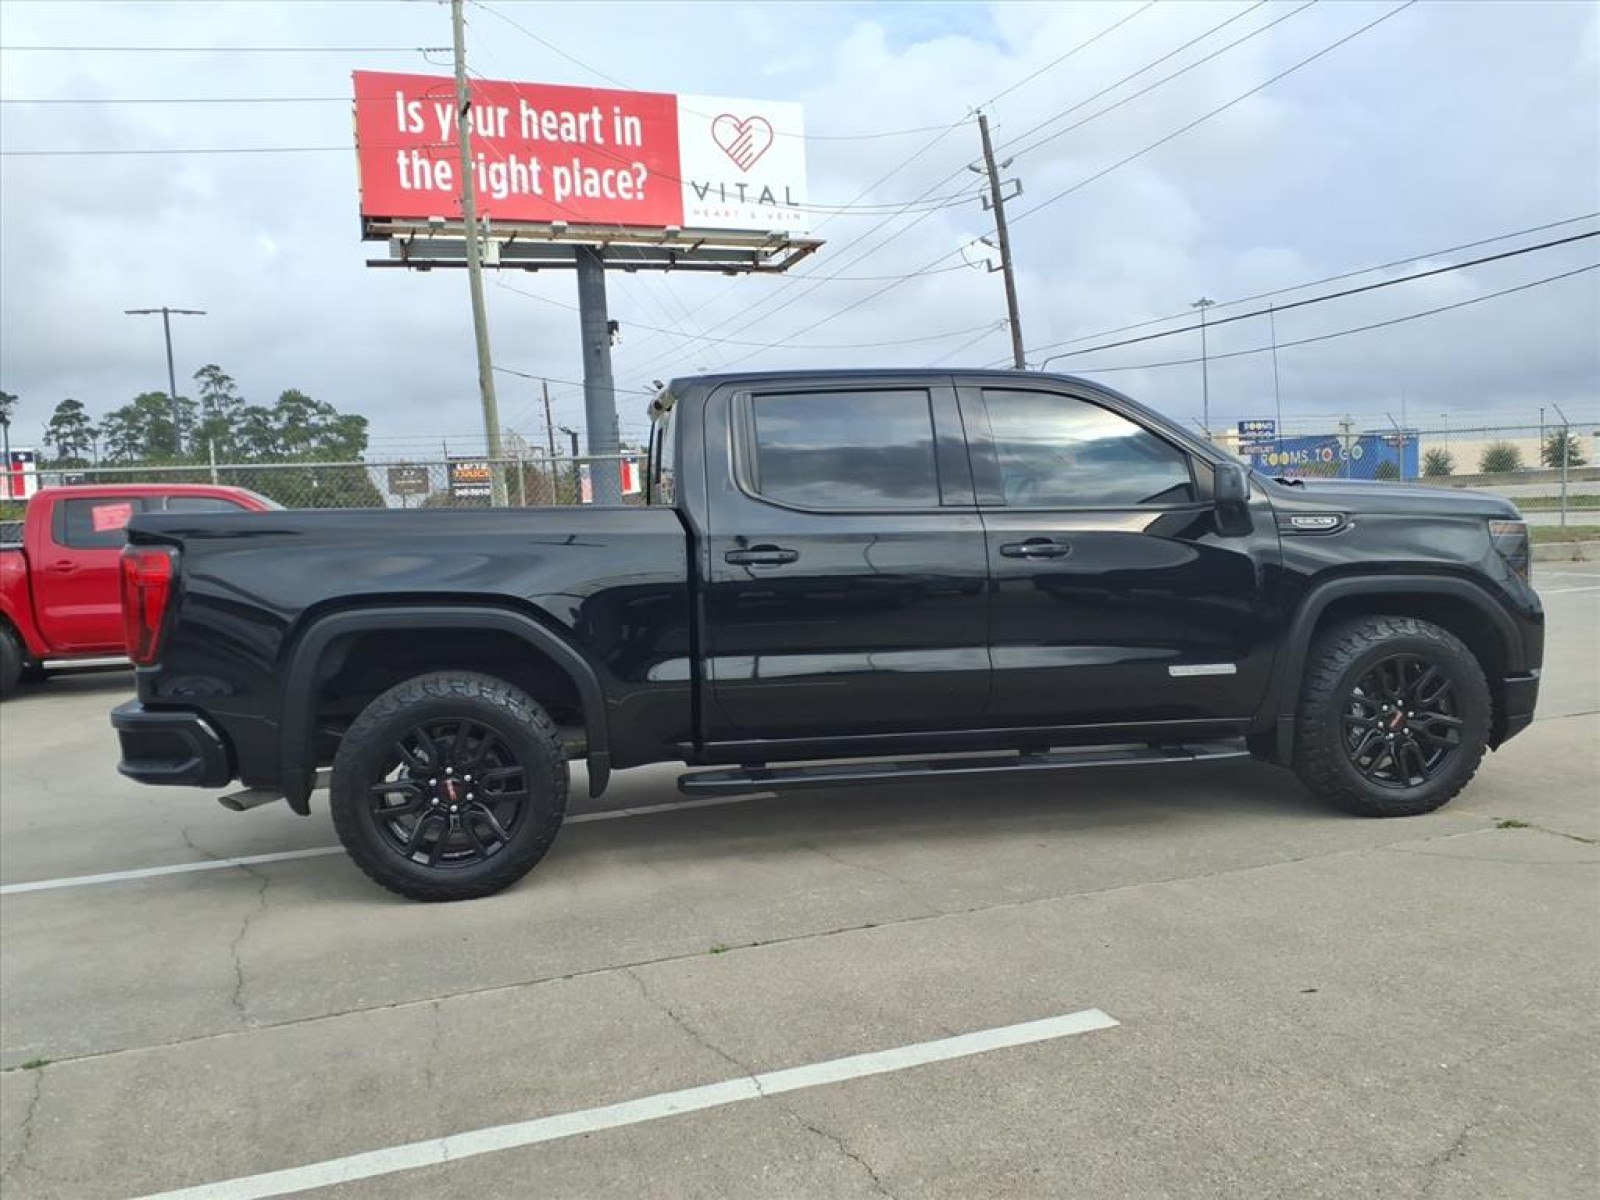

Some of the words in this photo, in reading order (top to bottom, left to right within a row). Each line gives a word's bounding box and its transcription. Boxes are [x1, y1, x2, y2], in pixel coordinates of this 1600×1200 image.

[396, 90, 424, 133] Is
[520, 98, 605, 145] heart
[613, 105, 643, 147] in
[396, 149, 453, 191] the
[471, 152, 543, 199] ight
[552, 157, 648, 203] place?
[691, 180, 799, 207] VITAL
[1260, 449, 1309, 467] ROOMS
